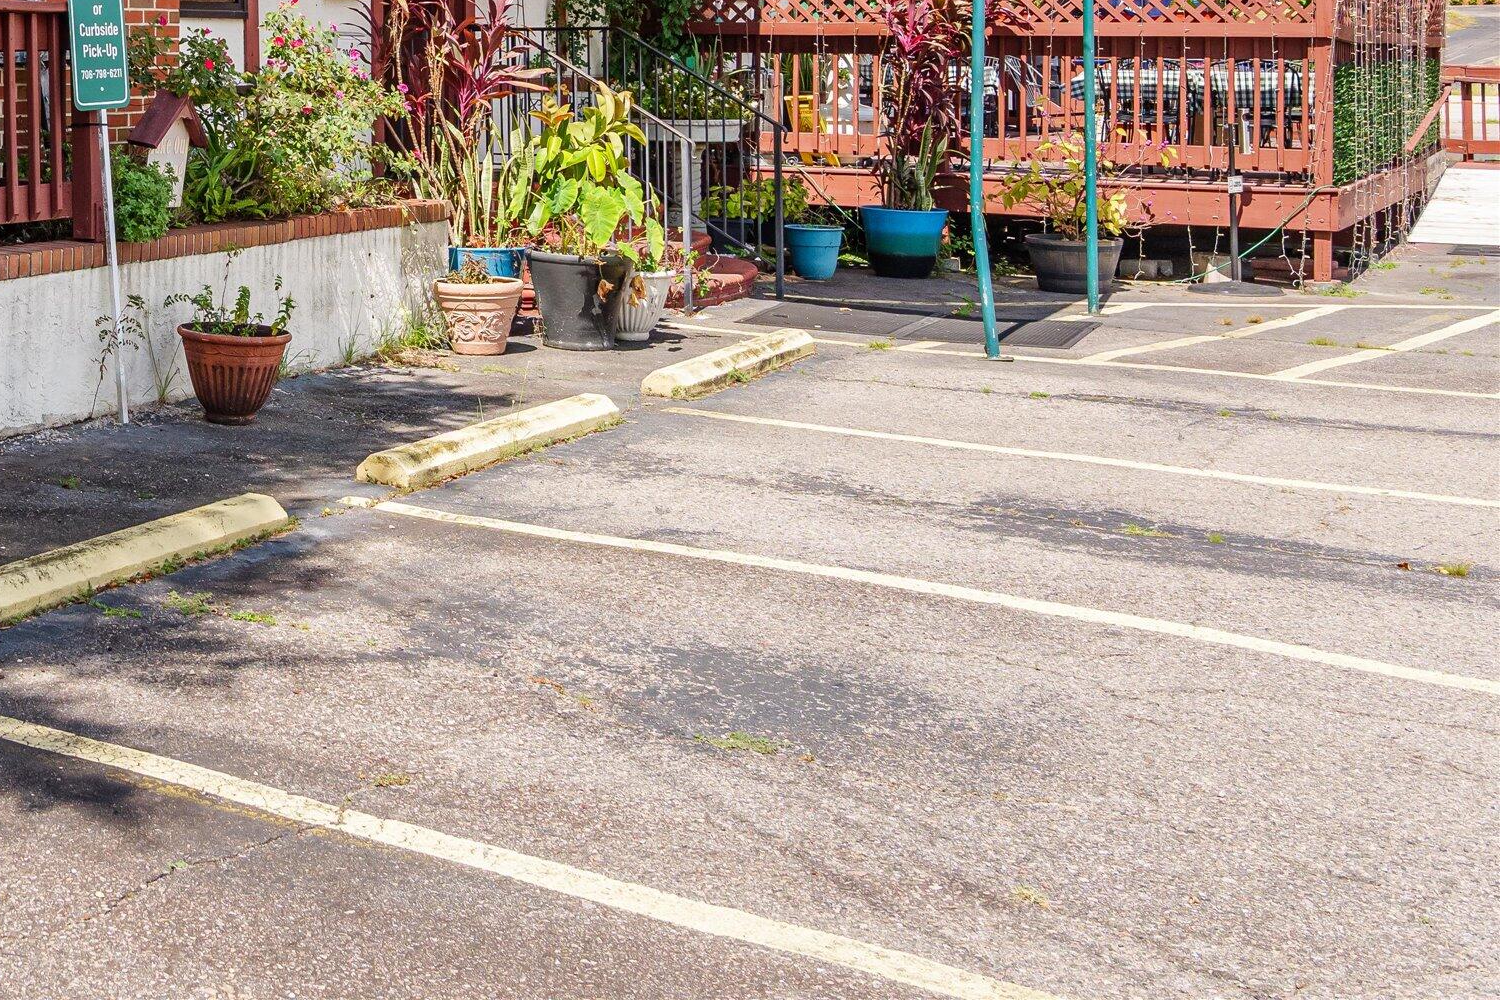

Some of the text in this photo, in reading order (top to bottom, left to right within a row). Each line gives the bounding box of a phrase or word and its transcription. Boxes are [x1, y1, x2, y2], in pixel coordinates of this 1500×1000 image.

[92, 3, 103, 16] or
[79, 22, 119, 37] Curbside
[82, 43, 118, 59] Pick-Up
[80, 68, 122, 80] 706-798-6211
